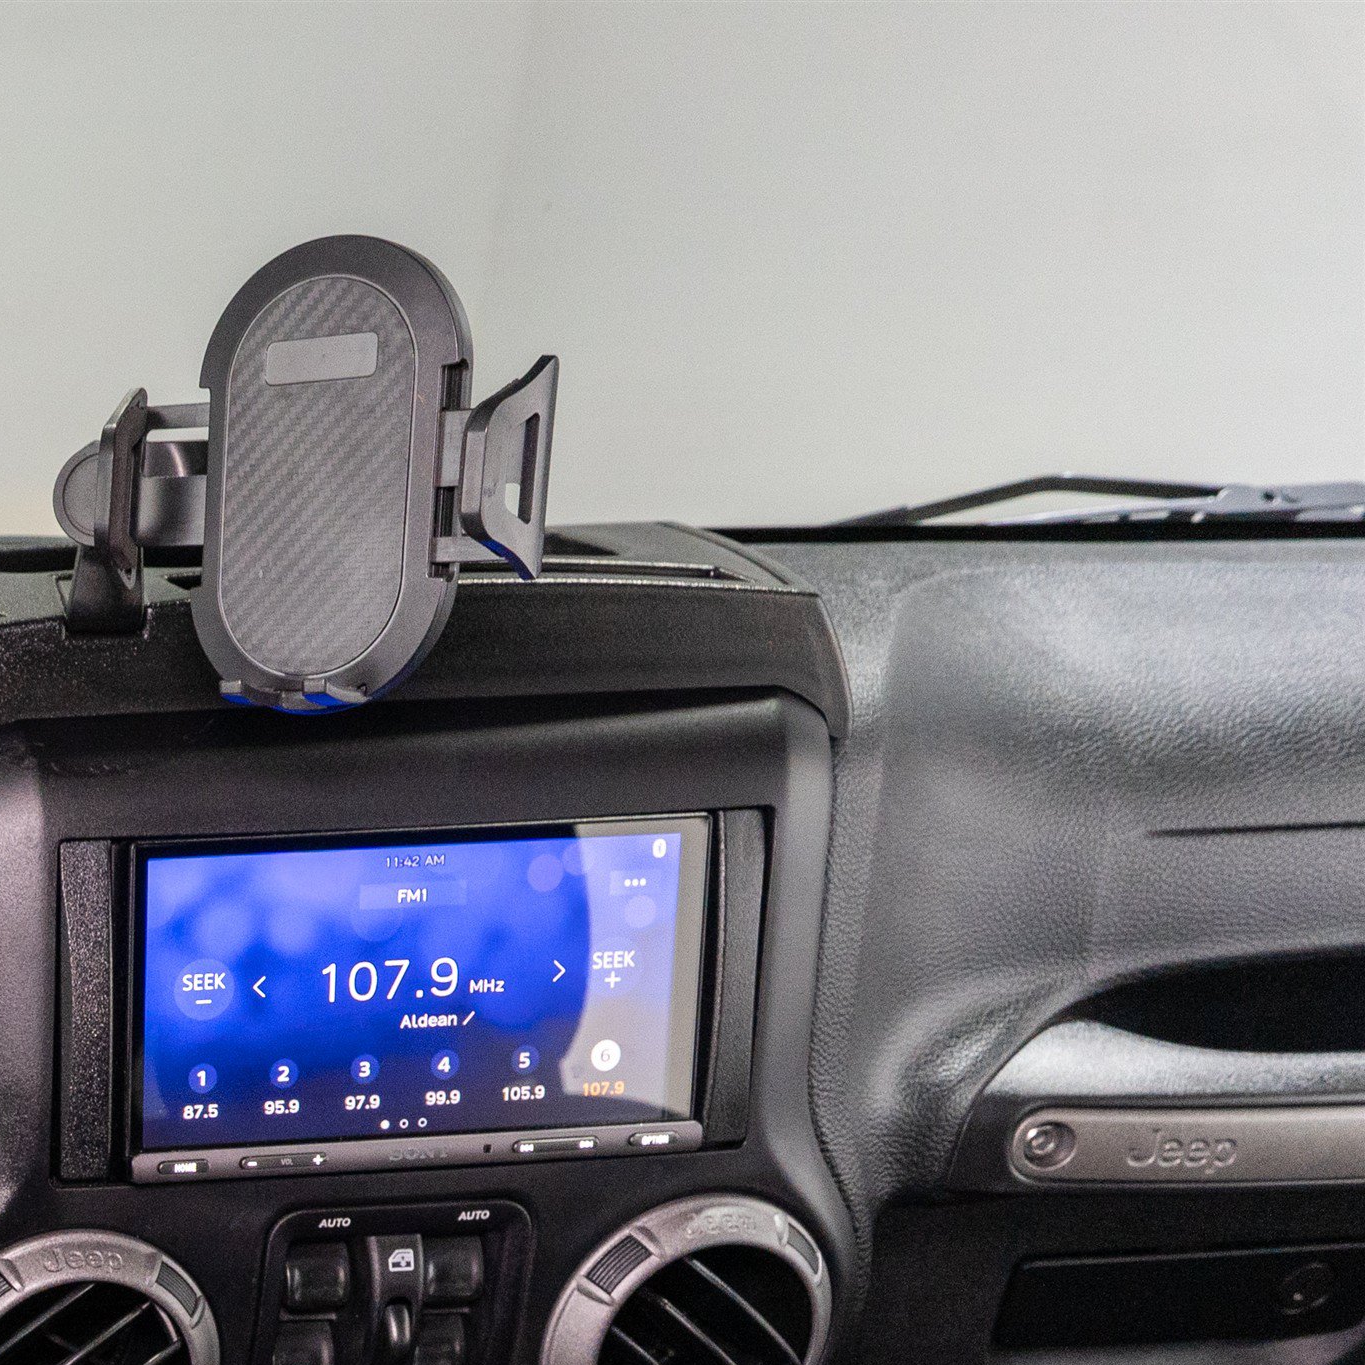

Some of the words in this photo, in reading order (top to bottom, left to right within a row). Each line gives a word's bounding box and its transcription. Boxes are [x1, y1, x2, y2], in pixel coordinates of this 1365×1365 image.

[386, 855, 420, 868] 11:42
[425, 854, 445, 866] AM
[397, 888, 428, 903] FM1
[592, 950, 636, 970] SEEK
[182, 971, 226, 991] SEEK
[321, 957, 459, 1003] 107.9
[469, 979, 505, 993] MHz
[400, 1012, 458, 1029] Aldean
[519, 1052, 531, 1069] 5
[600, 1048, 611, 1063] 6
[358, 1061, 370, 1078] 3
[437, 1056, 451, 1073] 4
[196, 1070, 206, 1086] 1
[277, 1065, 290, 1082] 2
[425, 1089, 461, 1105] 99.9
[502, 1085, 546, 1102] 105.9
[582, 1080, 625, 1097] 107.9
[264, 1099, 300, 1115] 95.9
[344, 1095, 380, 1110] 97.9
[183, 1104, 219, 1120] 87.5
[1126, 1126, 1237, 1174] Jeep
[318, 1217, 351, 1229] AUTO
[458, 1209, 490, 1222] AUTO
[43, 1247, 123, 1274] Jeep
